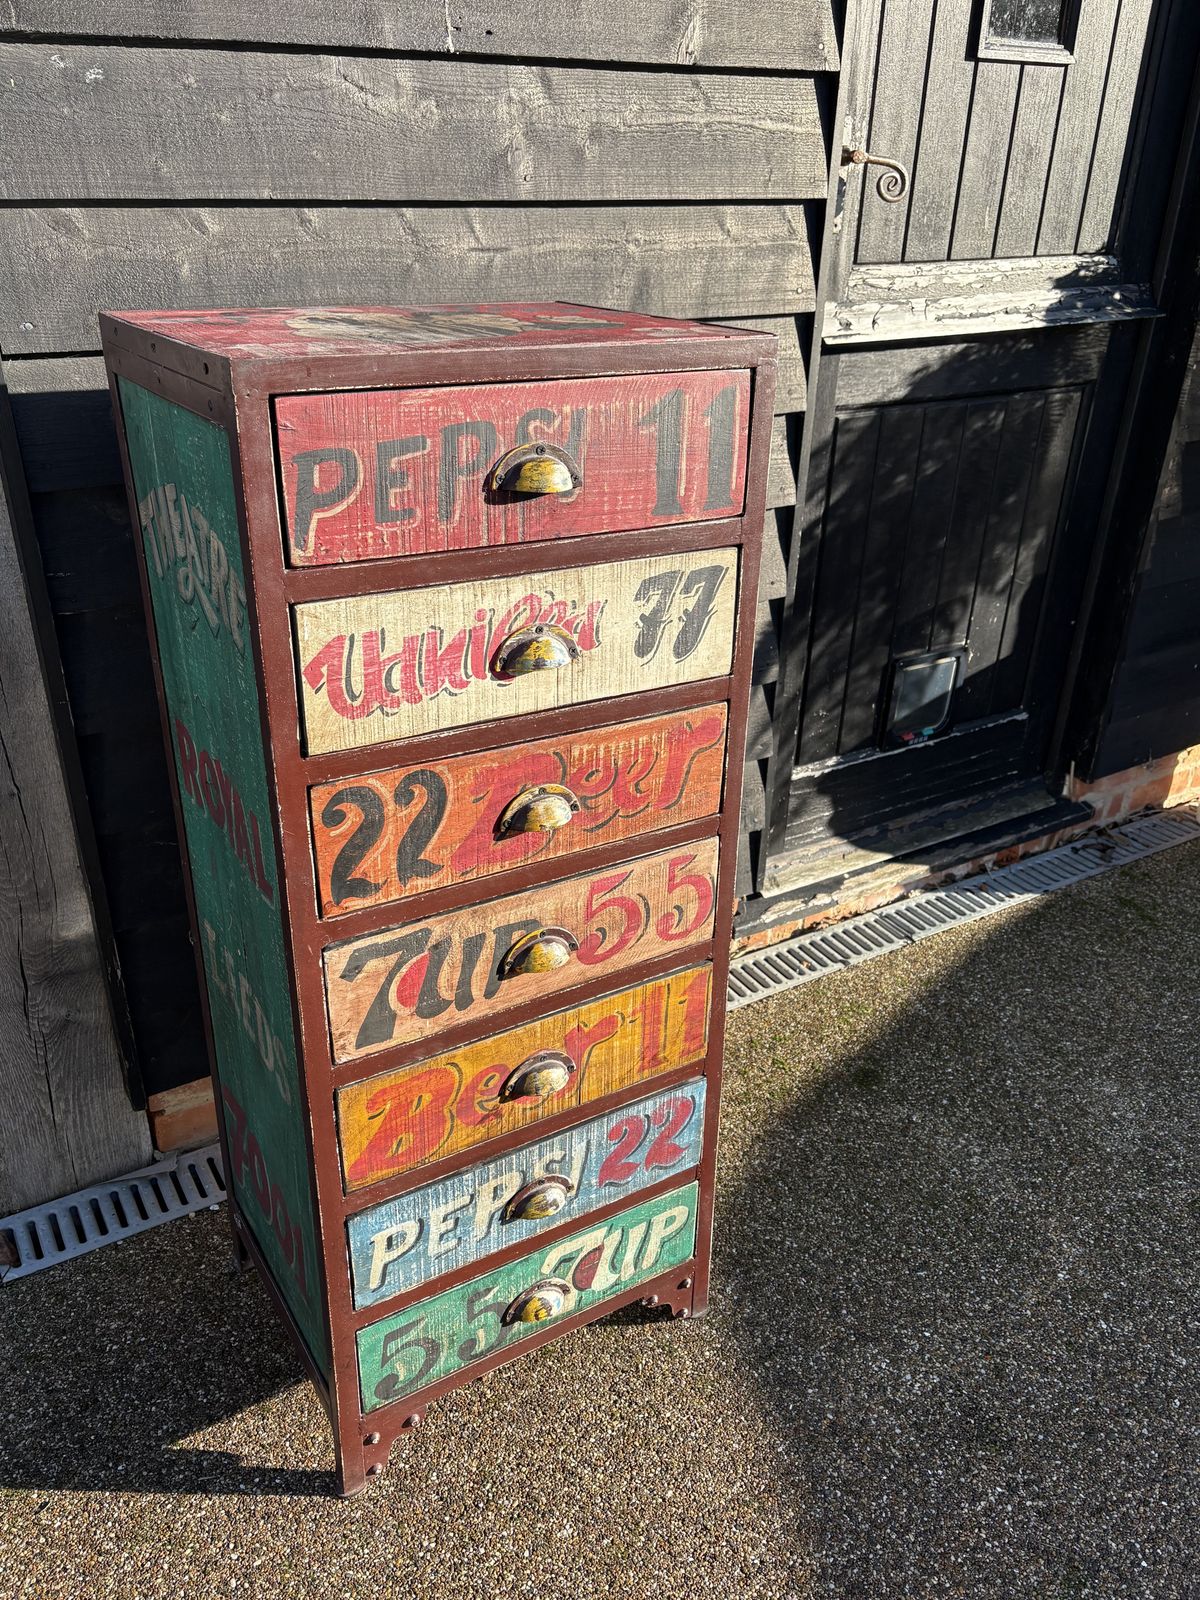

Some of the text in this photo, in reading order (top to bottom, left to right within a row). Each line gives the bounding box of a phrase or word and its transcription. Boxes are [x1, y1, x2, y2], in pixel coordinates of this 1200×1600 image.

[636, 385, 740, 516] 11
[138, 484, 248, 658] THEATRE
[632, 564, 729, 664] 77
[174, 718, 275, 910] ROYAL
[321, 769, 457, 906] 22
[576, 854, 716, 966] 55
[203, 919, 293, 1106] LEEDS
[348, 969, 712, 1182] Ber 11
[598, 1094, 697, 1189] 22
